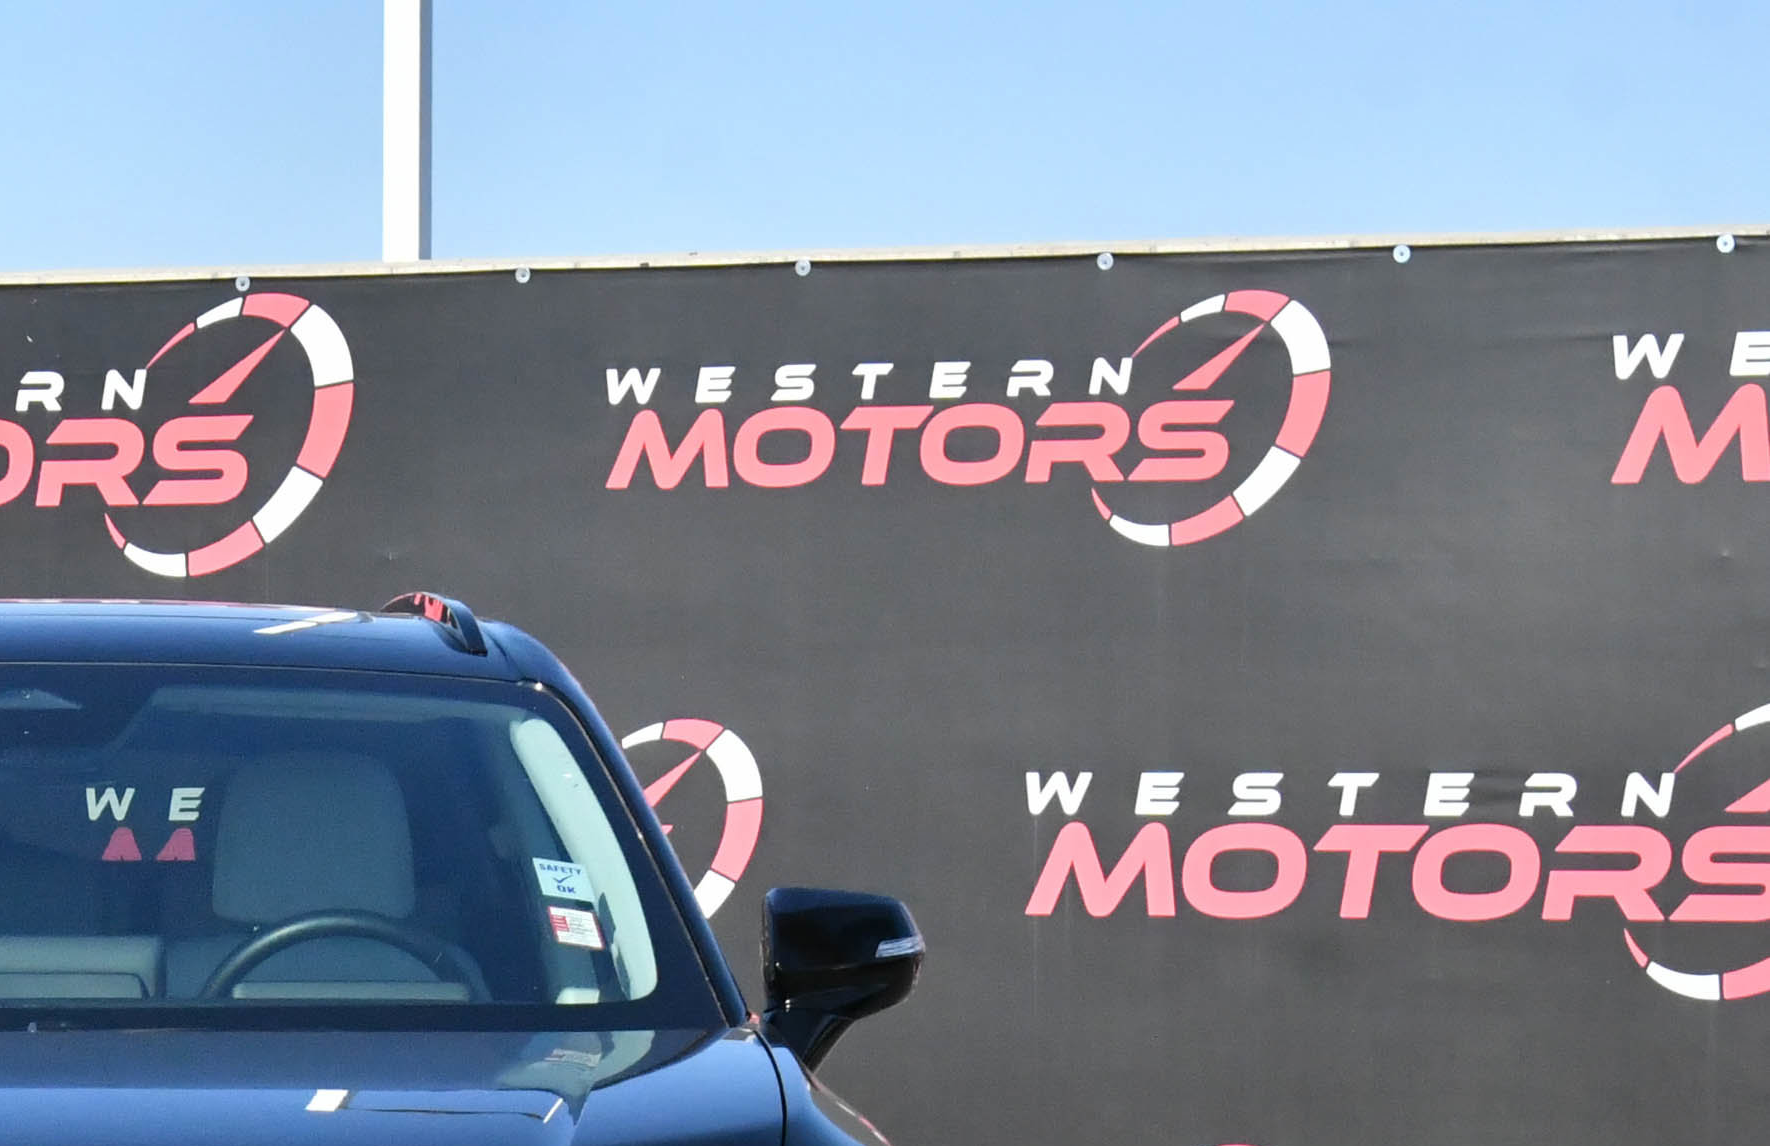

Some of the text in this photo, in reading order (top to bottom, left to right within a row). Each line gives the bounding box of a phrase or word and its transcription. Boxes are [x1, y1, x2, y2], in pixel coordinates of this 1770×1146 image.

[1613, 332, 1770, 380] WE
[607, 358, 1132, 404] WESTERN
[605, 400, 1235, 491] MOTORS
[1026, 772, 1675, 818] WESTERN
[539, 863, 582, 875] SAFETY
[556, 884, 576, 894] OK
